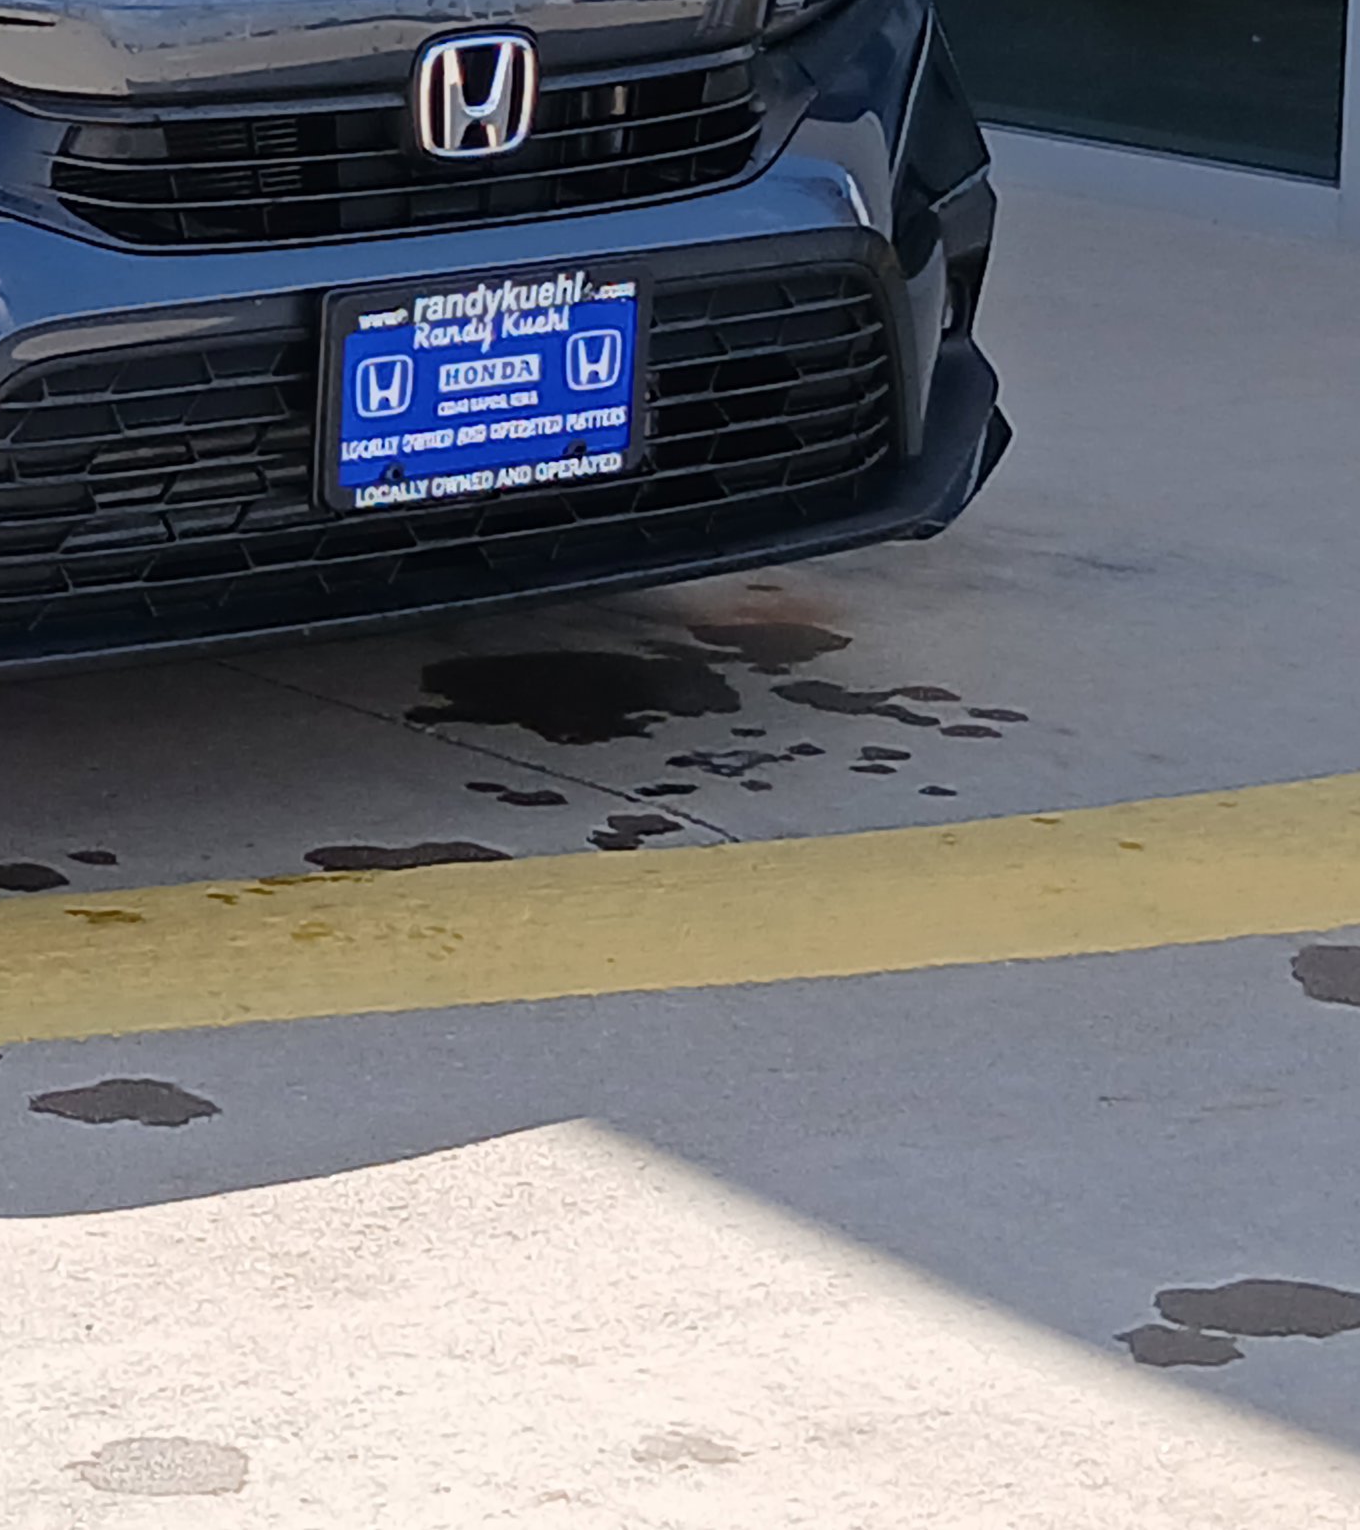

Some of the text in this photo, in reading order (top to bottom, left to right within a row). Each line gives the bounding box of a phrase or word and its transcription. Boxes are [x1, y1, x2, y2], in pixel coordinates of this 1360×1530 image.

[413, 304, 570, 354] Randy Kuehl
[444, 359, 534, 387] HONDA
[355, 452, 622, 508] LOCALLY OWNED AND OPERATED
